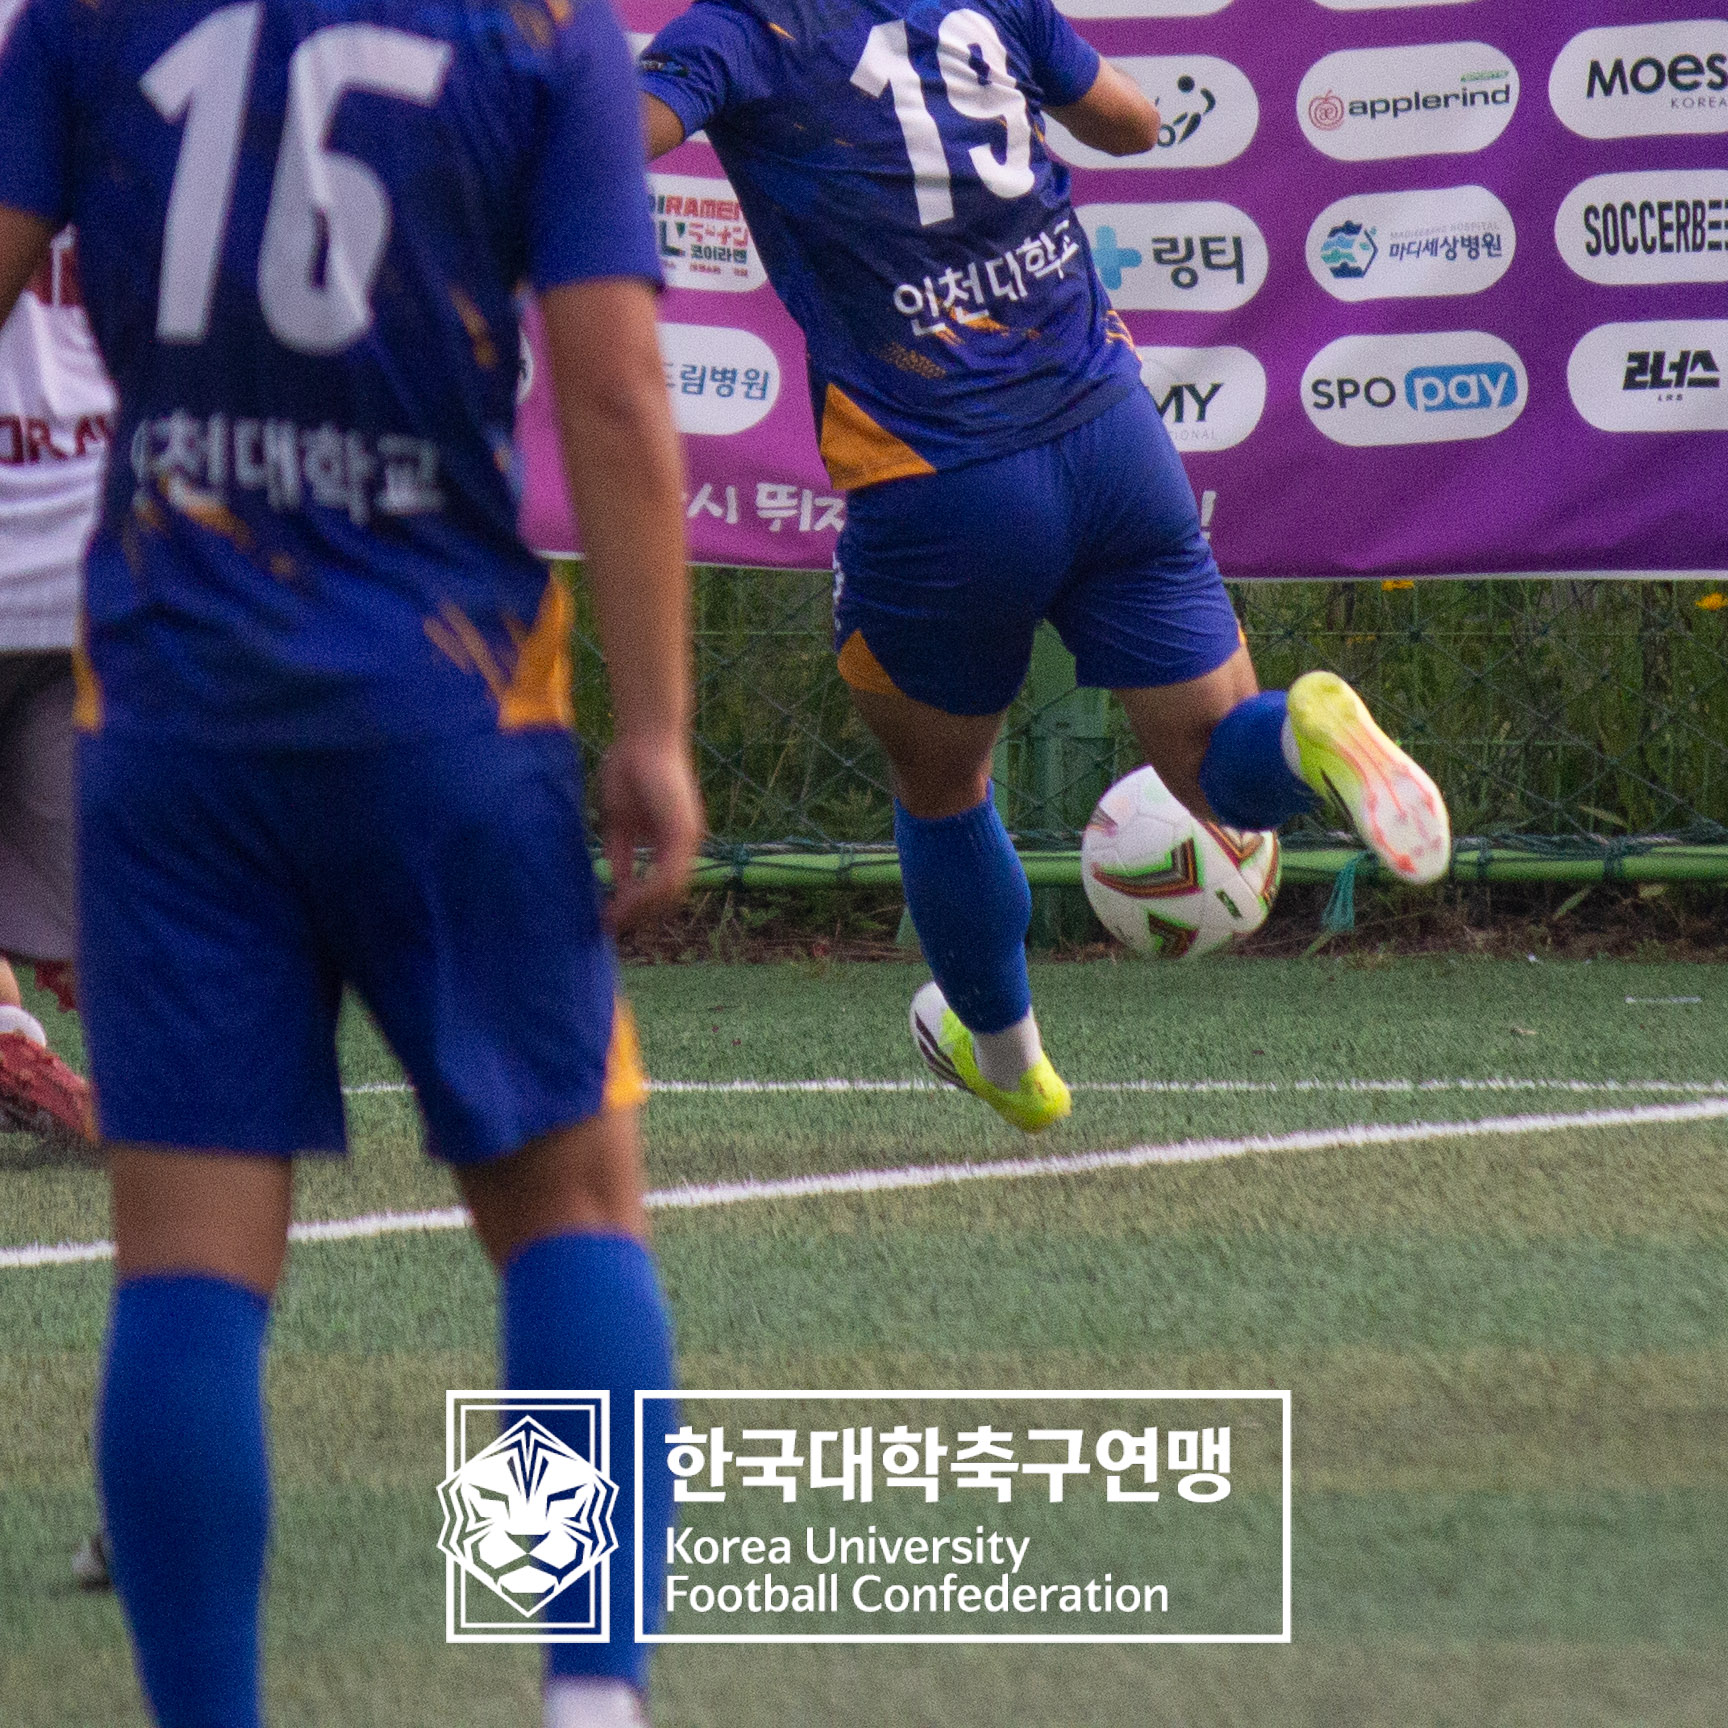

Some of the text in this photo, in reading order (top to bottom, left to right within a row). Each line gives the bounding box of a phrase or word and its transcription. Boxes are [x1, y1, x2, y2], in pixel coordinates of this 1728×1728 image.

[850, 7, 1035, 227] 19
[1348, 84, 1512, 120] applerind
[1672, 94, 1728, 109] KOREA
[1152, 235, 1245, 289] 링티
[1389, 232, 1504, 262] 마디세상병원
[1311, 371, 1509, 413] SPO pay
